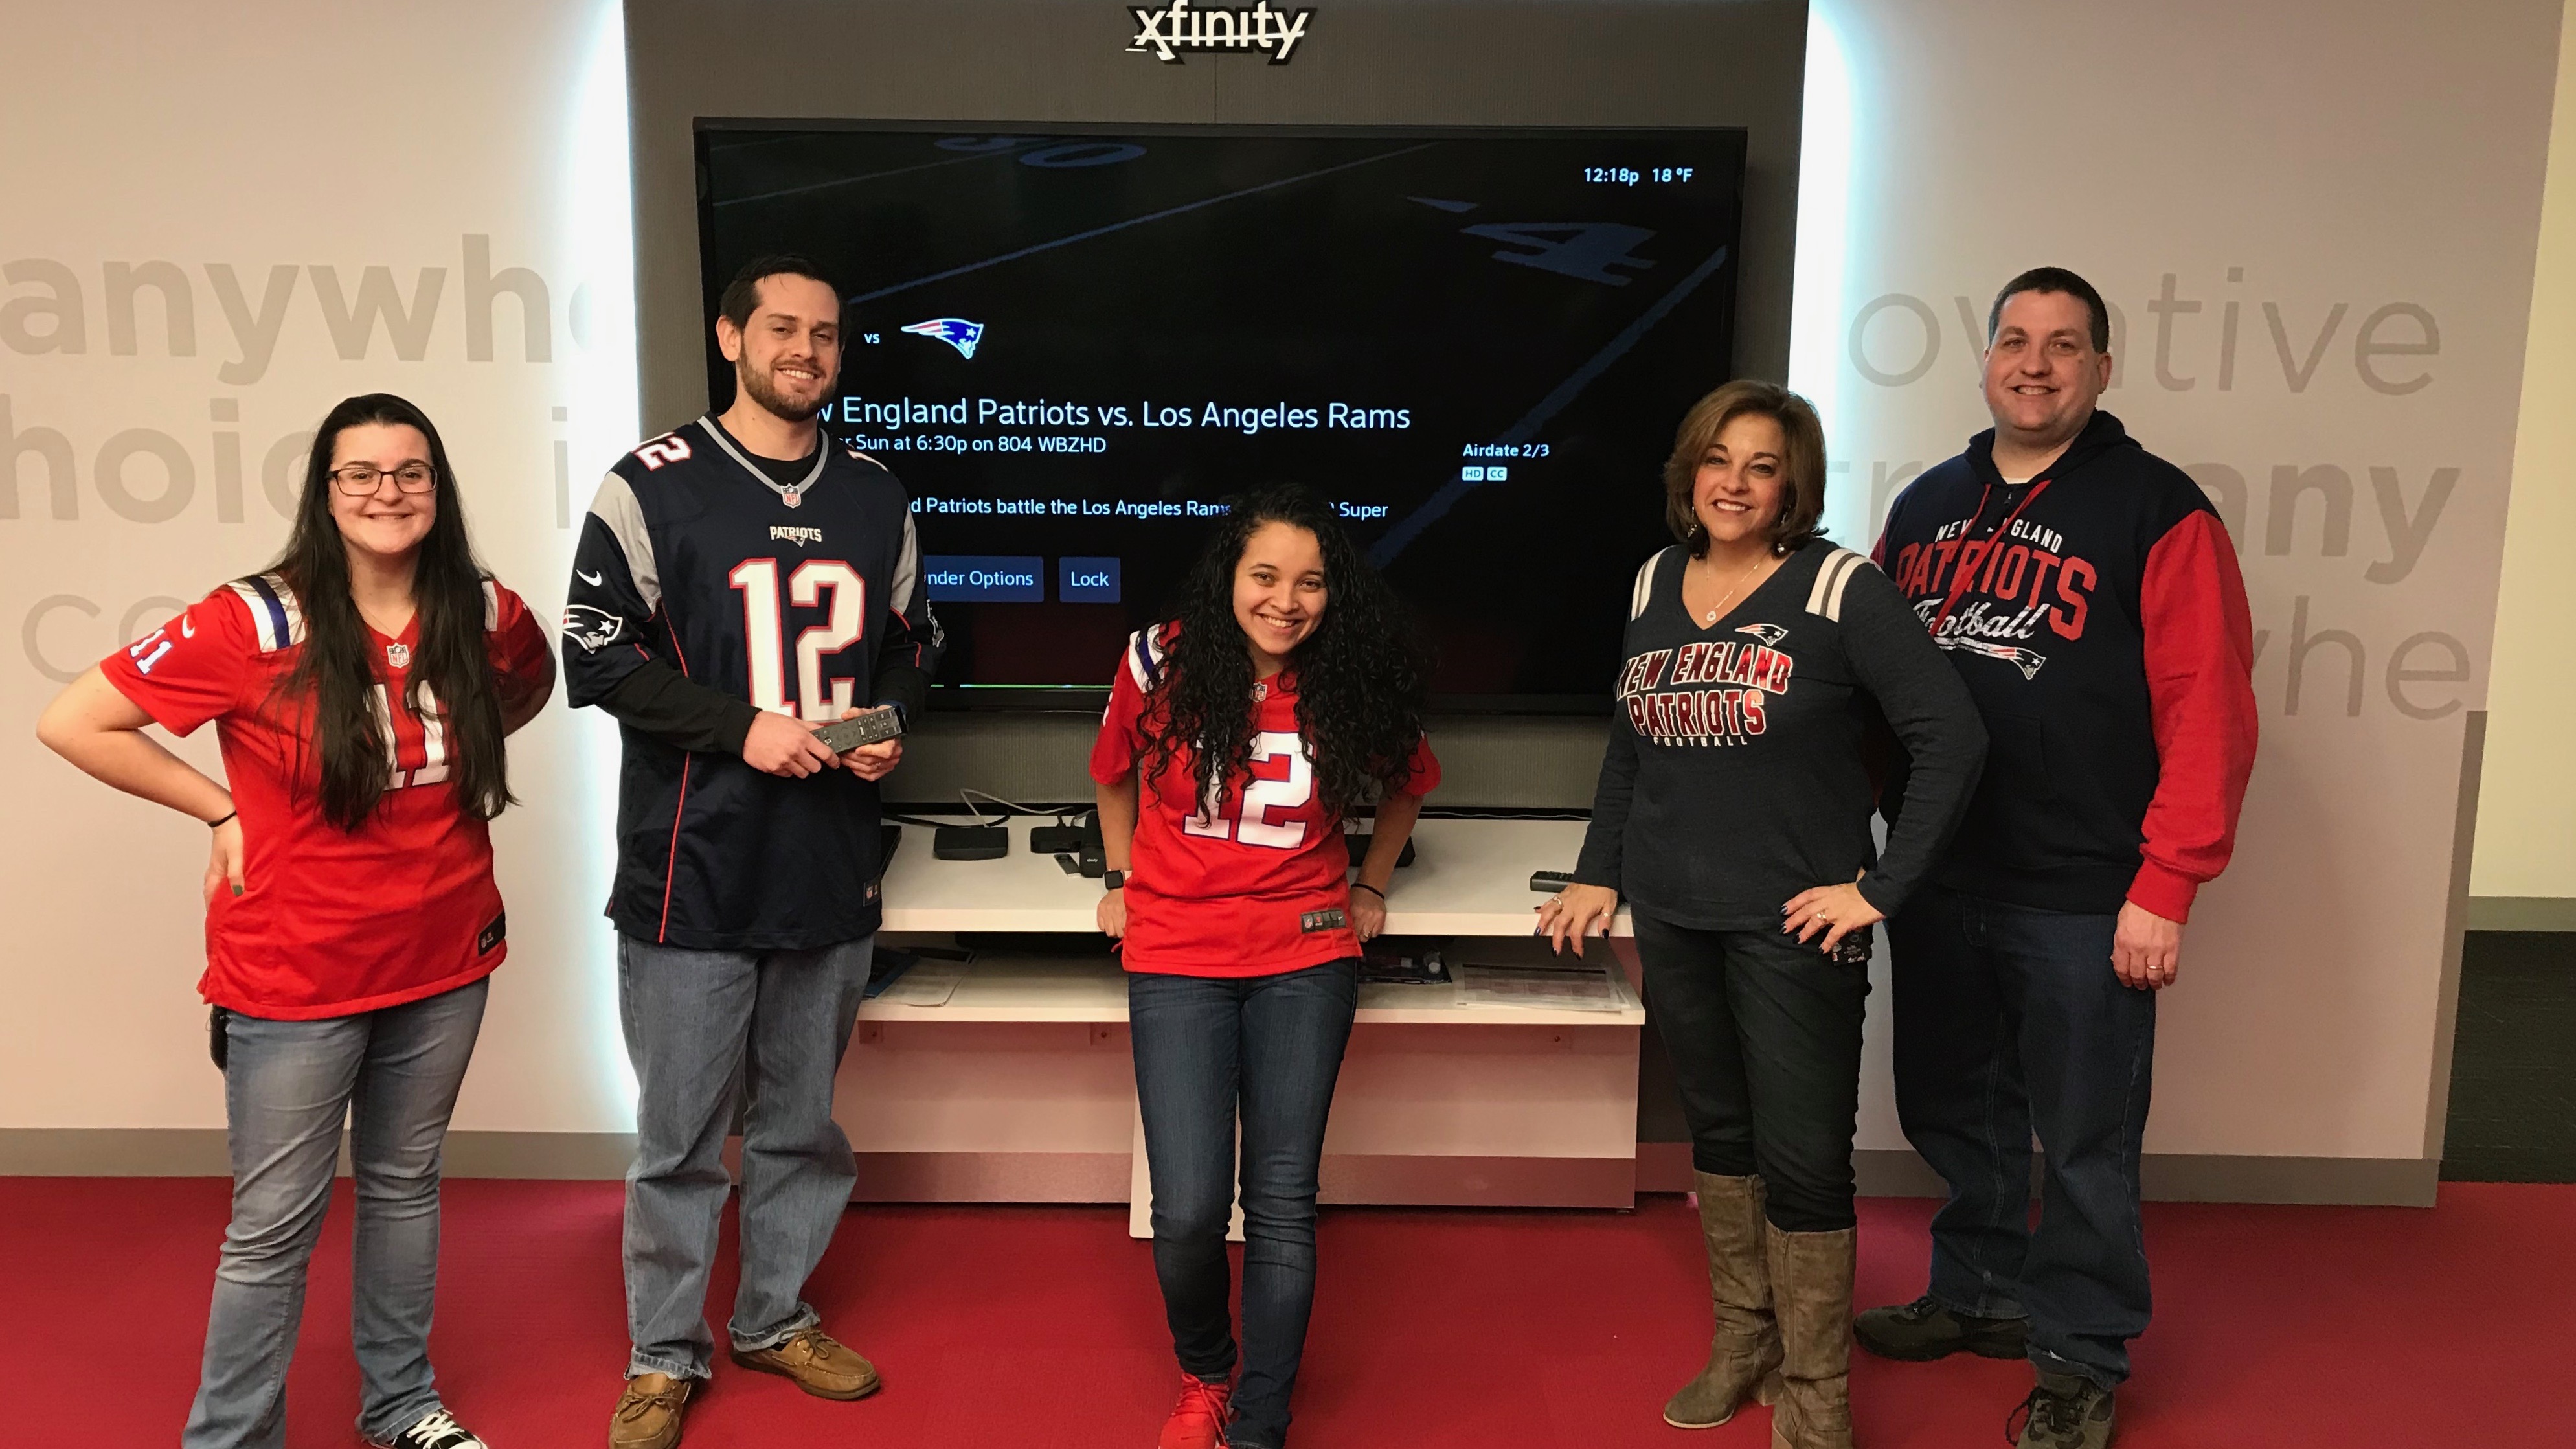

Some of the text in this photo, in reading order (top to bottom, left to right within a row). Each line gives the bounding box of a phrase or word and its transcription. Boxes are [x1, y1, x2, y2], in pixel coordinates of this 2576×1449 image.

[1125, 0, 1309, 60] xfinity
[1584, 168, 1640, 187] 12:18p
[0, 233, 592, 386] anywh
[864, 333, 880, 344] vs
[843, 396, 967, 430] England
[978, 398, 1089, 426] Patriots
[1097, 406, 1133, 426] vs.
[1144, 400, 1192, 427] Los
[1201, 401, 1318, 435] Angeles
[1329, 402, 1410, 429] Rams
[855, 434, 889, 450] Sun
[894, 435, 911, 451] at
[916, 435, 967, 455] 6:30p
[971, 439, 993, 451] on
[998, 435, 1033, 452] 804
[1037, 436, 1107, 453] WBZHD
[1463, 443, 1550, 459] Airdate 2/3
[1465, 468, 1505, 479] HD CC
[926, 497, 992, 514] Patriots
[997, 498, 1046, 514] battle
[1050, 499, 1078, 515] the
[1083, 499, 1111, 515] Los
[1114, 499, 1182, 519] Angeles
[1339, 501, 1389, 521] Super
[769, 525, 822, 542] PATRIOTS
[1987, 518, 2064, 554] GLAND
[923, 570, 1034, 589] nder Options
[1071, 571, 1109, 587] Lock
[1895, 540, 2098, 642] PATRIOTS
[130, 627, 173, 675] 11
[728, 557, 866, 727] 12
[392, 654, 408, 664] NFL
[1617, 642, 1793, 702] NEW ENGLAND
[1627, 689, 1767, 737] PATRIOTS
[1652, 736, 1748, 747] FOOTBALL
[1182, 731, 1315, 850] 12
